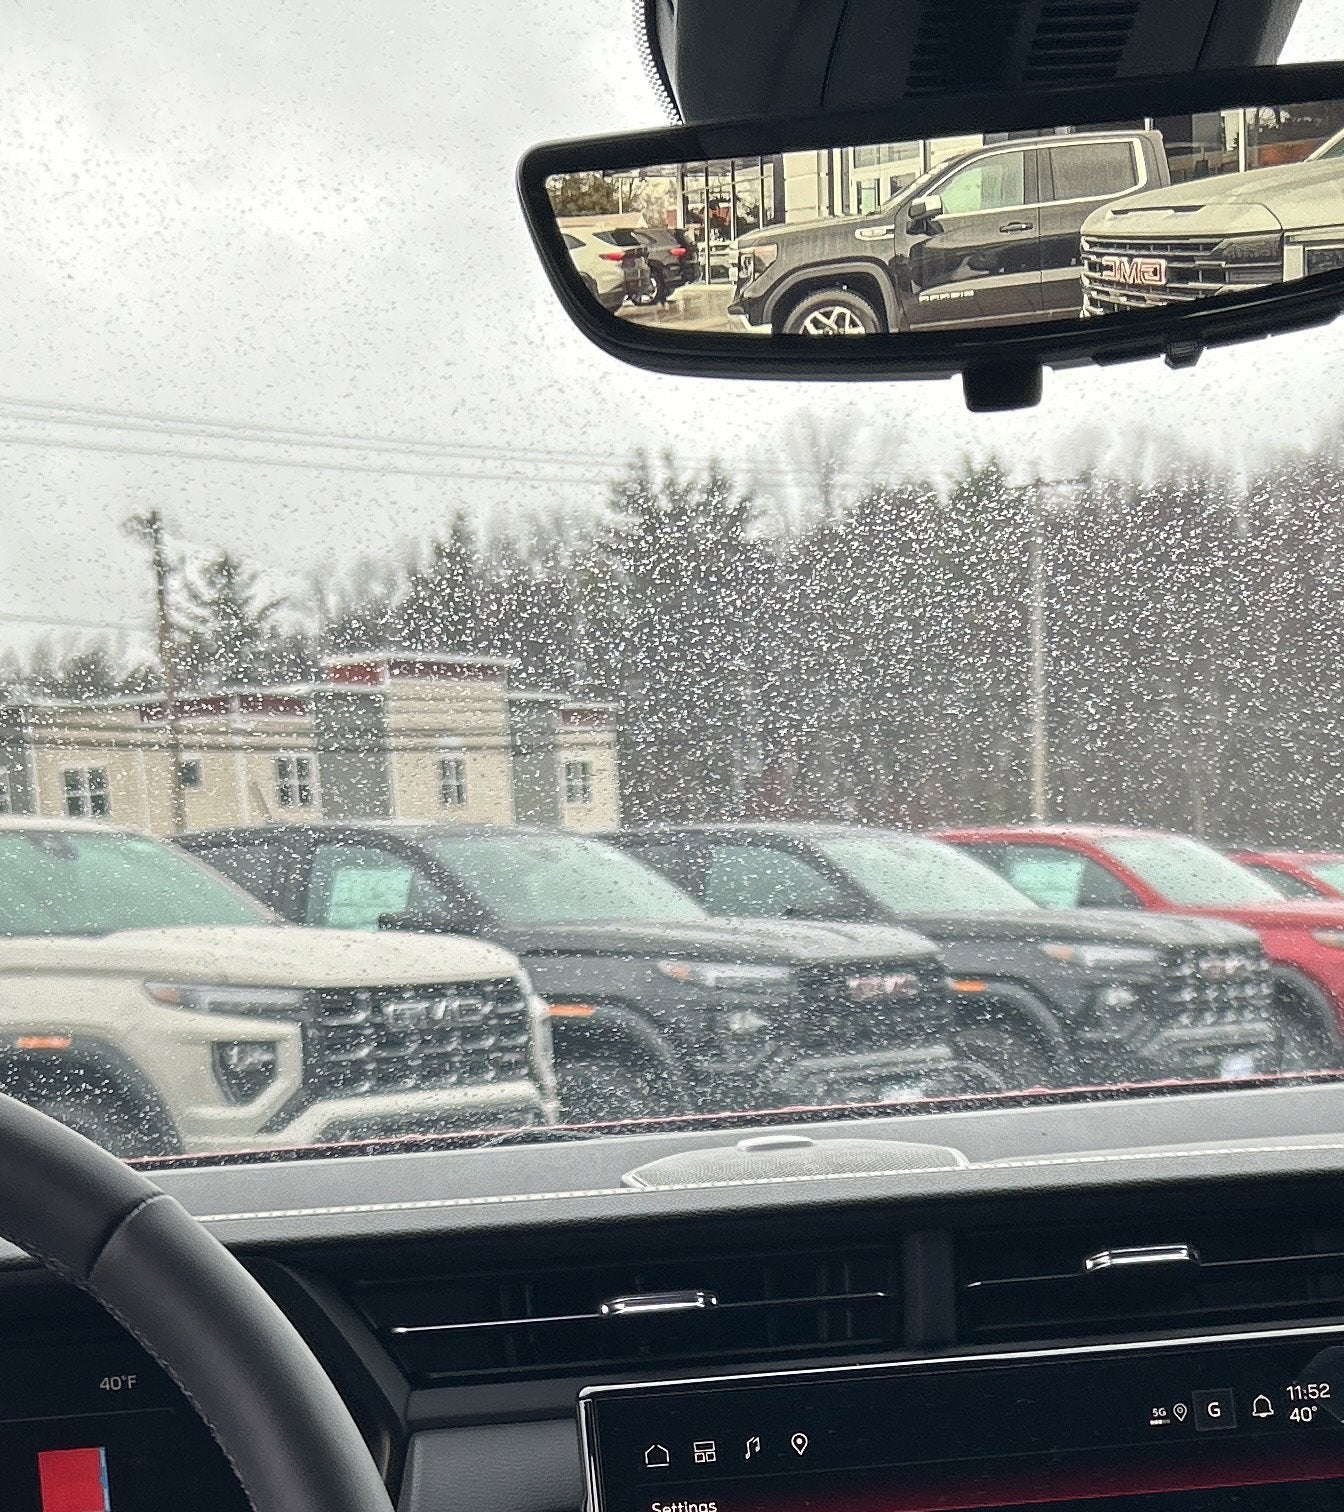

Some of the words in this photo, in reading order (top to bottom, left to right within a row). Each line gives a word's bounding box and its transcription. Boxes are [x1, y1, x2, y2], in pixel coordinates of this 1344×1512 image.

[99, 1374, 137, 1391] 40°F
[1286, 1383, 1332, 1402] 11:52
[1152, 1407, 1167, 1418] 5G
[1207, 1401, 1221, 1418] G
[1289, 1406, 1319, 1423] 40°
